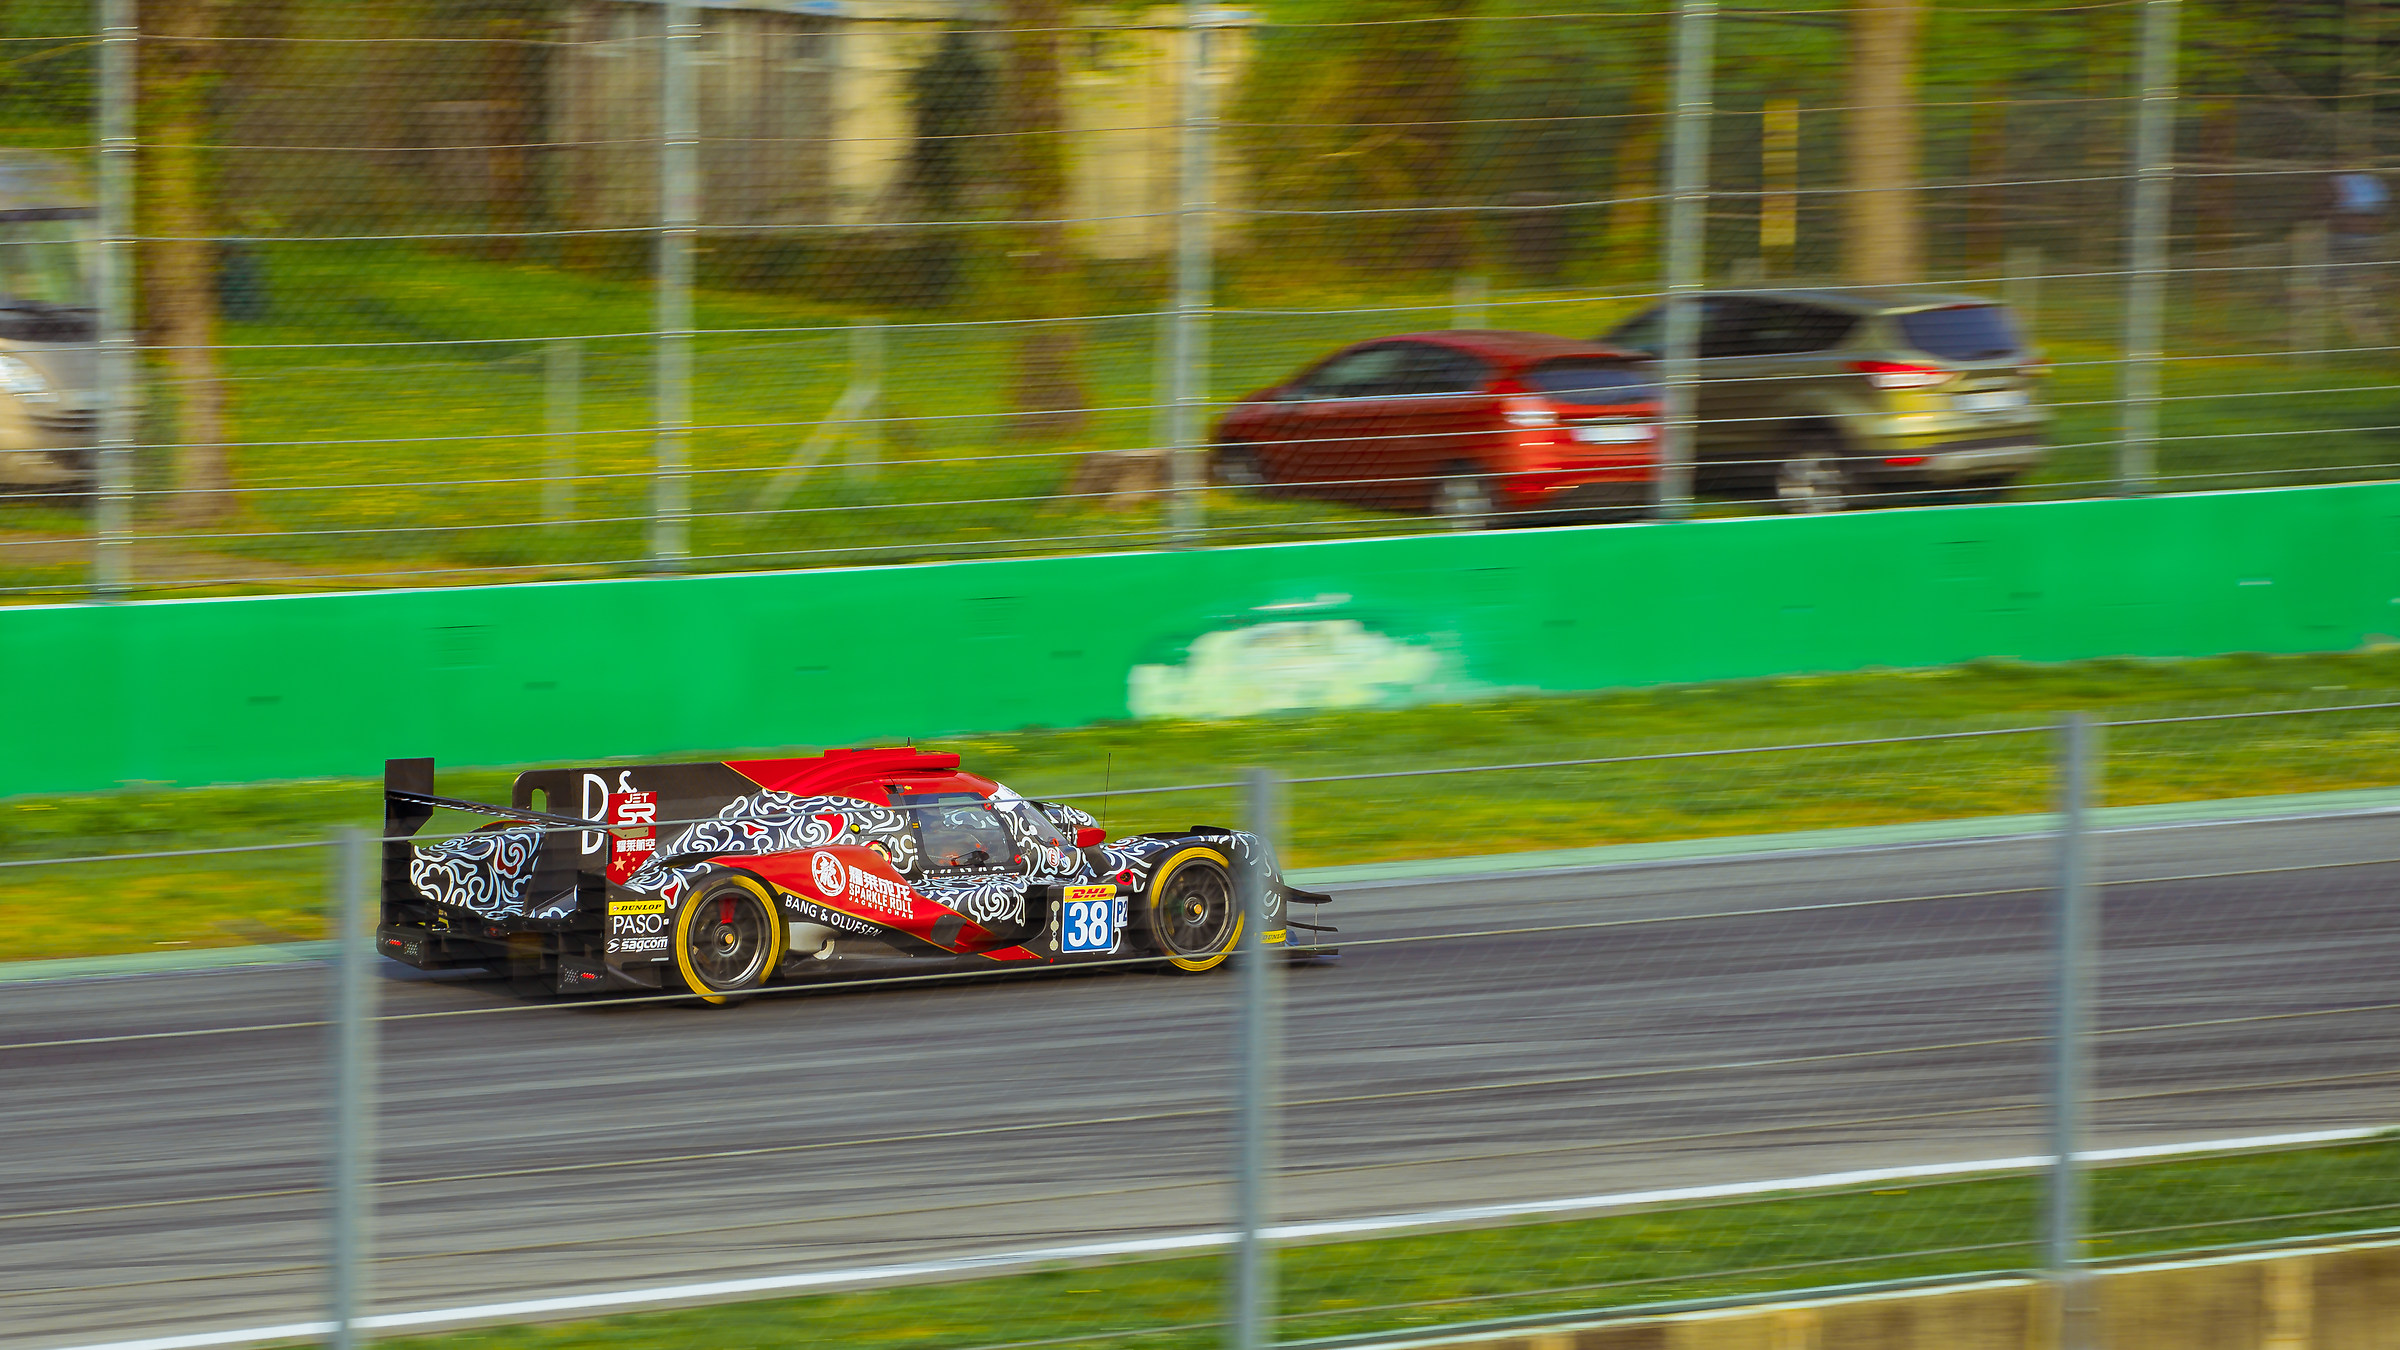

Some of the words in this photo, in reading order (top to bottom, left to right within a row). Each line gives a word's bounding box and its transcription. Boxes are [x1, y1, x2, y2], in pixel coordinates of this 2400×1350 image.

[624, 792, 650, 804] JET
[617, 802, 656, 827] SR
[849, 882, 888, 907] SPARKLE
[889, 896, 914, 914] ROLL
[1072, 887, 1108, 899] DHL
[785, 894, 817, 918] BANG
[820, 908, 828, 922] &
[831, 912, 883, 937] OLUFSEN
[1116, 900, 1128, 923] P2
[613, 913, 662, 935] PASO
[1068, 901, 1109, 947] 38
[620, 939, 669, 953] sagcom
